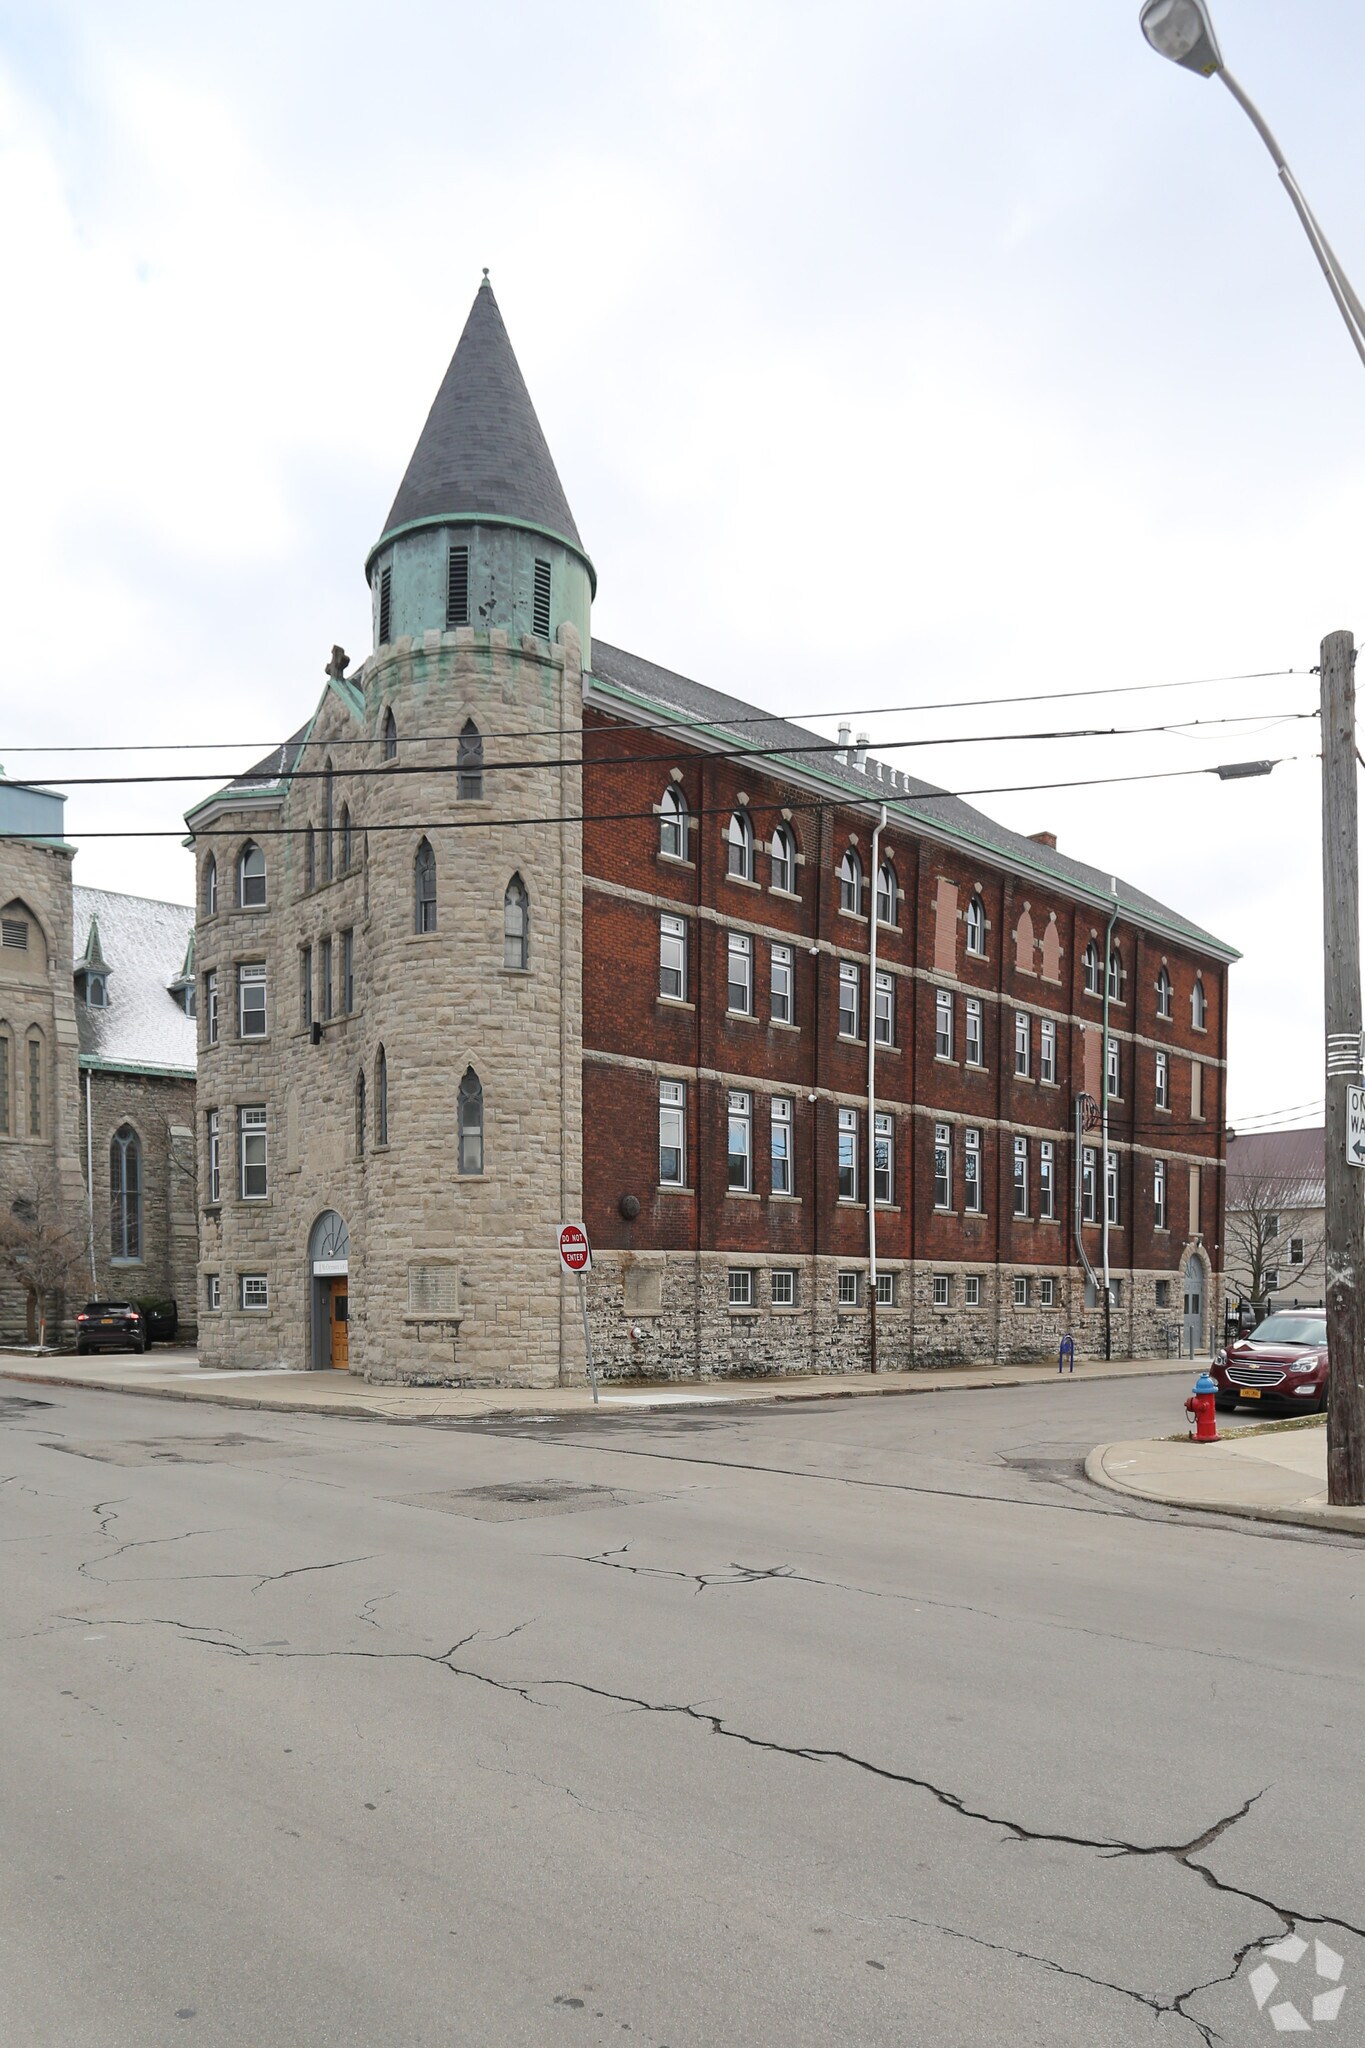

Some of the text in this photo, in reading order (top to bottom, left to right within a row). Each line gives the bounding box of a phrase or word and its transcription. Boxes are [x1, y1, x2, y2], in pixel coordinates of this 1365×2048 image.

[562, 1233, 582, 1242] DO NOT
[567, 1253, 583, 1261] ENTER
